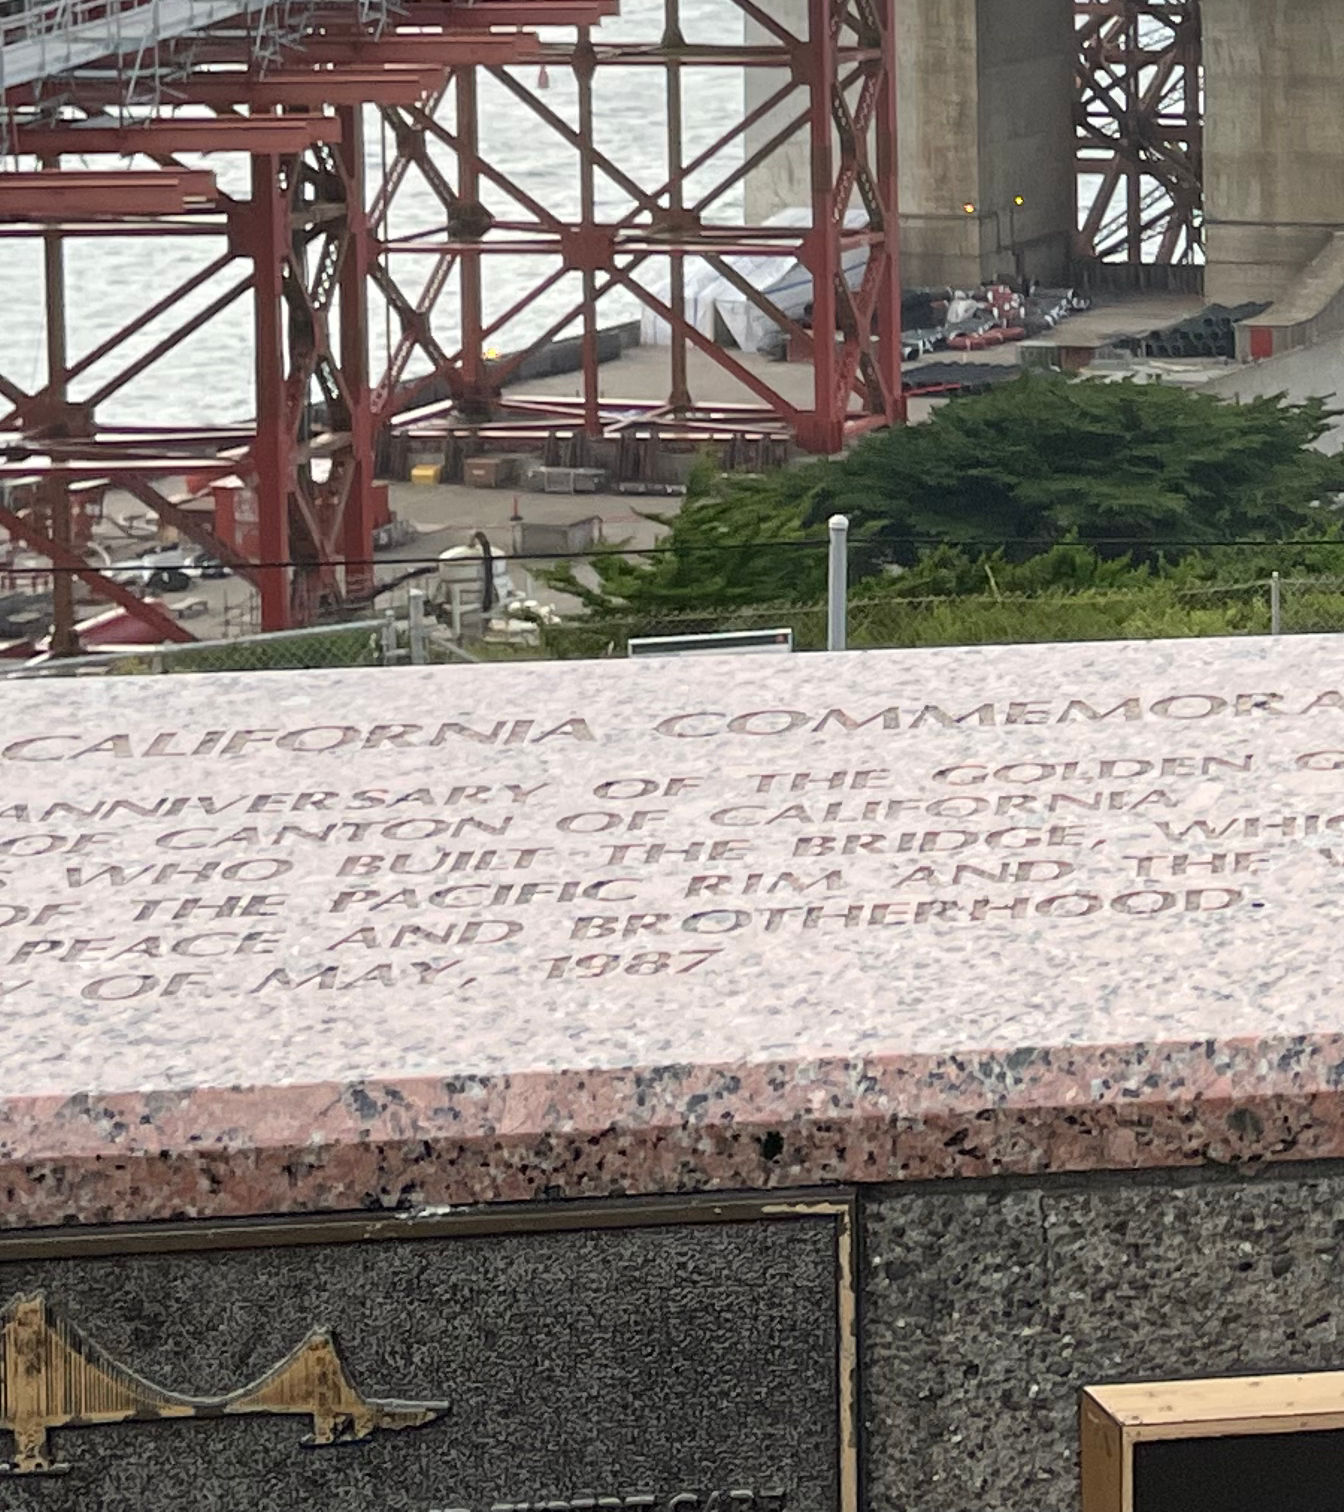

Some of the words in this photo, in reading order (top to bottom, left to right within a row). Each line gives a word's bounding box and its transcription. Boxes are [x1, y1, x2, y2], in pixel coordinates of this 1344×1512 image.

[1, 717, 596, 761] CALIFORNIA
[0, 782, 552, 823] ANNIVERSARY
[593, 776, 704, 799] OF
[747, 767, 891, 793] THE
[931, 753, 1254, 786] GOLDEN
[0, 832, 118, 857] OF
[155, 816, 514, 849] CANTON
[556, 808, 669, 833] OF
[709, 789, 1180, 827] CALIFORNIA
[66, 857, 294, 889] WHO
[335, 846, 554, 878] BUILT
[600, 839, 751, 866] THE
[792, 825, 1107, 858] BRIDGE,
[130, 892, 292, 923] THE
[328, 877, 644, 914] PACIFIC
[683, 869, 844, 900] RIM
[890, 860, 1076, 890] AND
[1121, 849, 1271, 878] THE
[6, 929, 287, 966] PEACE
[325, 919, 525, 951] AND
[80, 970, 214, 1002] OF
[248, 959, 478, 994] MAY,
[538, 947, 726, 980] 1987
